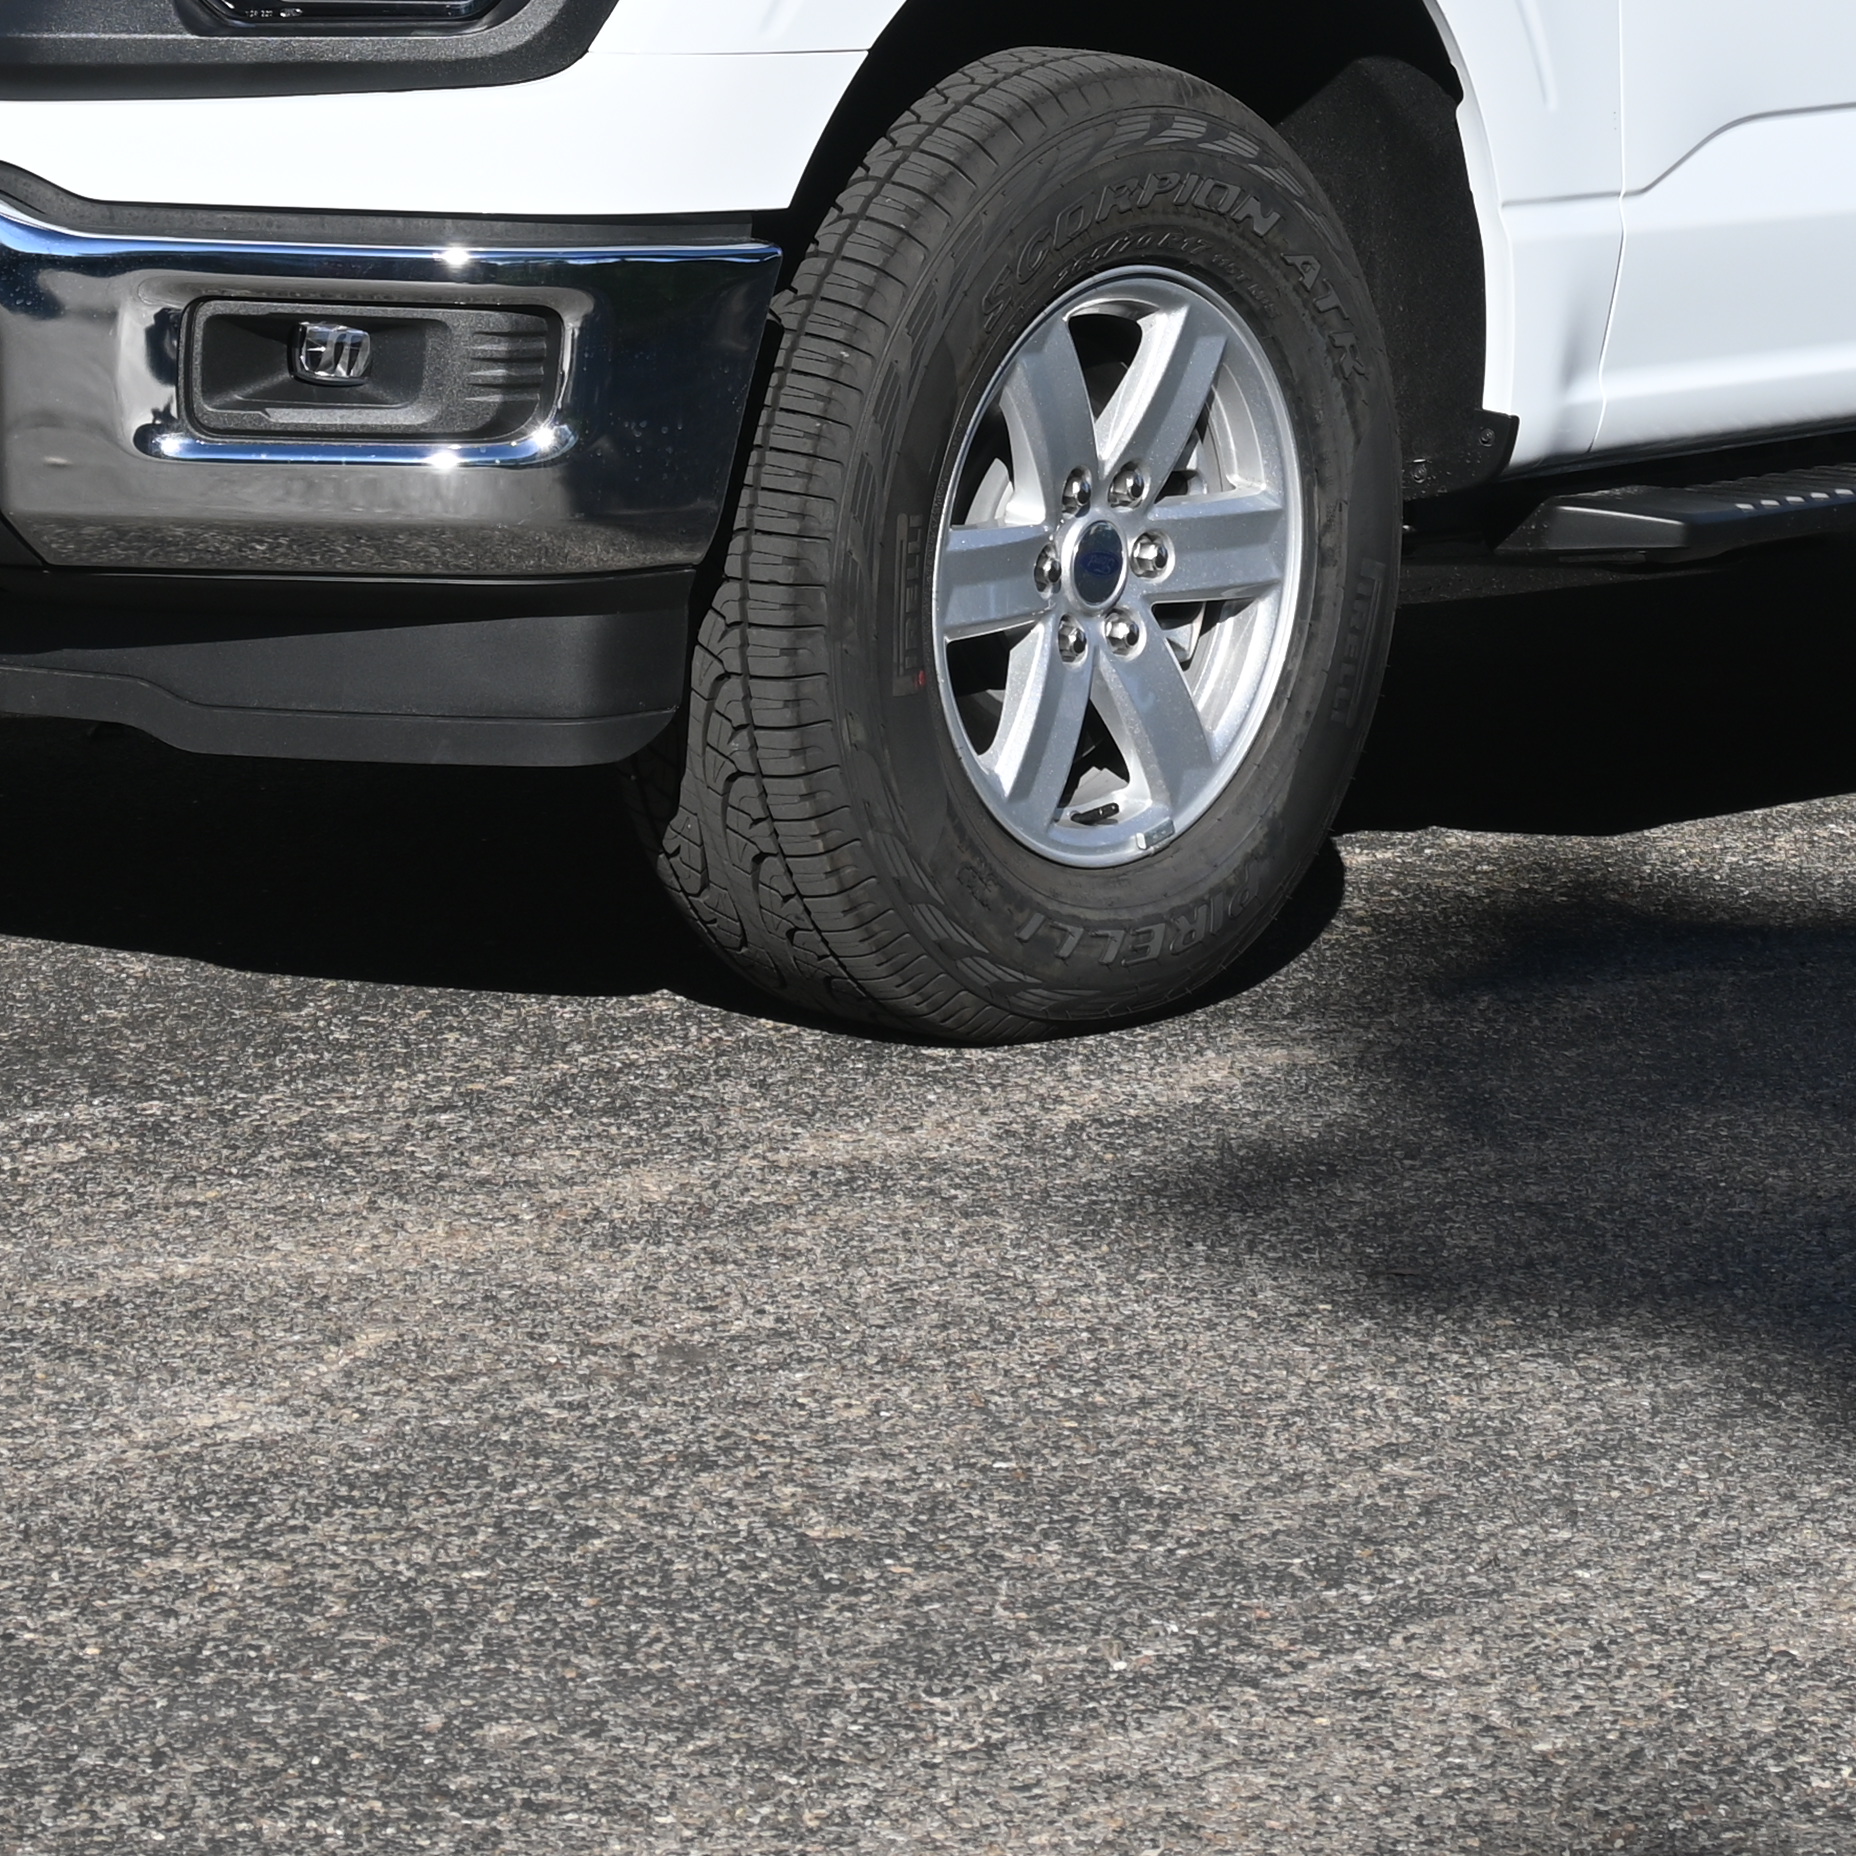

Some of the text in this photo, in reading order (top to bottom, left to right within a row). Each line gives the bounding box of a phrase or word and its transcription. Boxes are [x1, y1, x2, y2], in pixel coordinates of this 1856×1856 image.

[981, 171, 1370, 380] SCORPION ATR
[1013, 860, 1265, 968] PIRELLI
